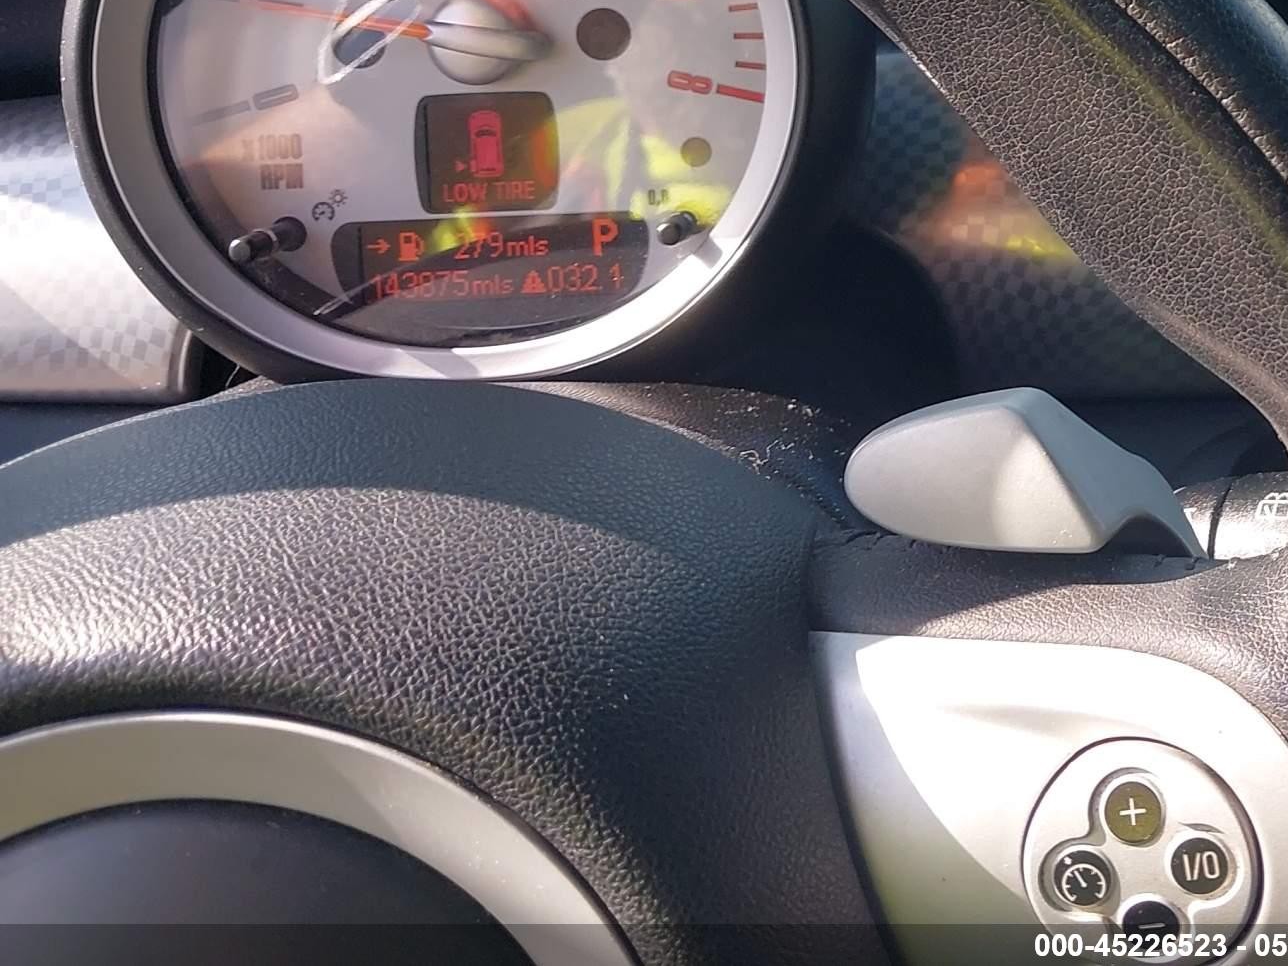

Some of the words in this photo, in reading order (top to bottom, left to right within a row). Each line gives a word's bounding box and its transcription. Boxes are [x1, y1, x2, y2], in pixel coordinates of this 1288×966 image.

[667, 70, 713, 95] 8
[252, 83, 299, 111] 0
[261, 164, 304, 190] RPM
[443, 183, 488, 203] LOW
[495, 181, 536, 202] TIRE
[591, 218, 619, 257] P
